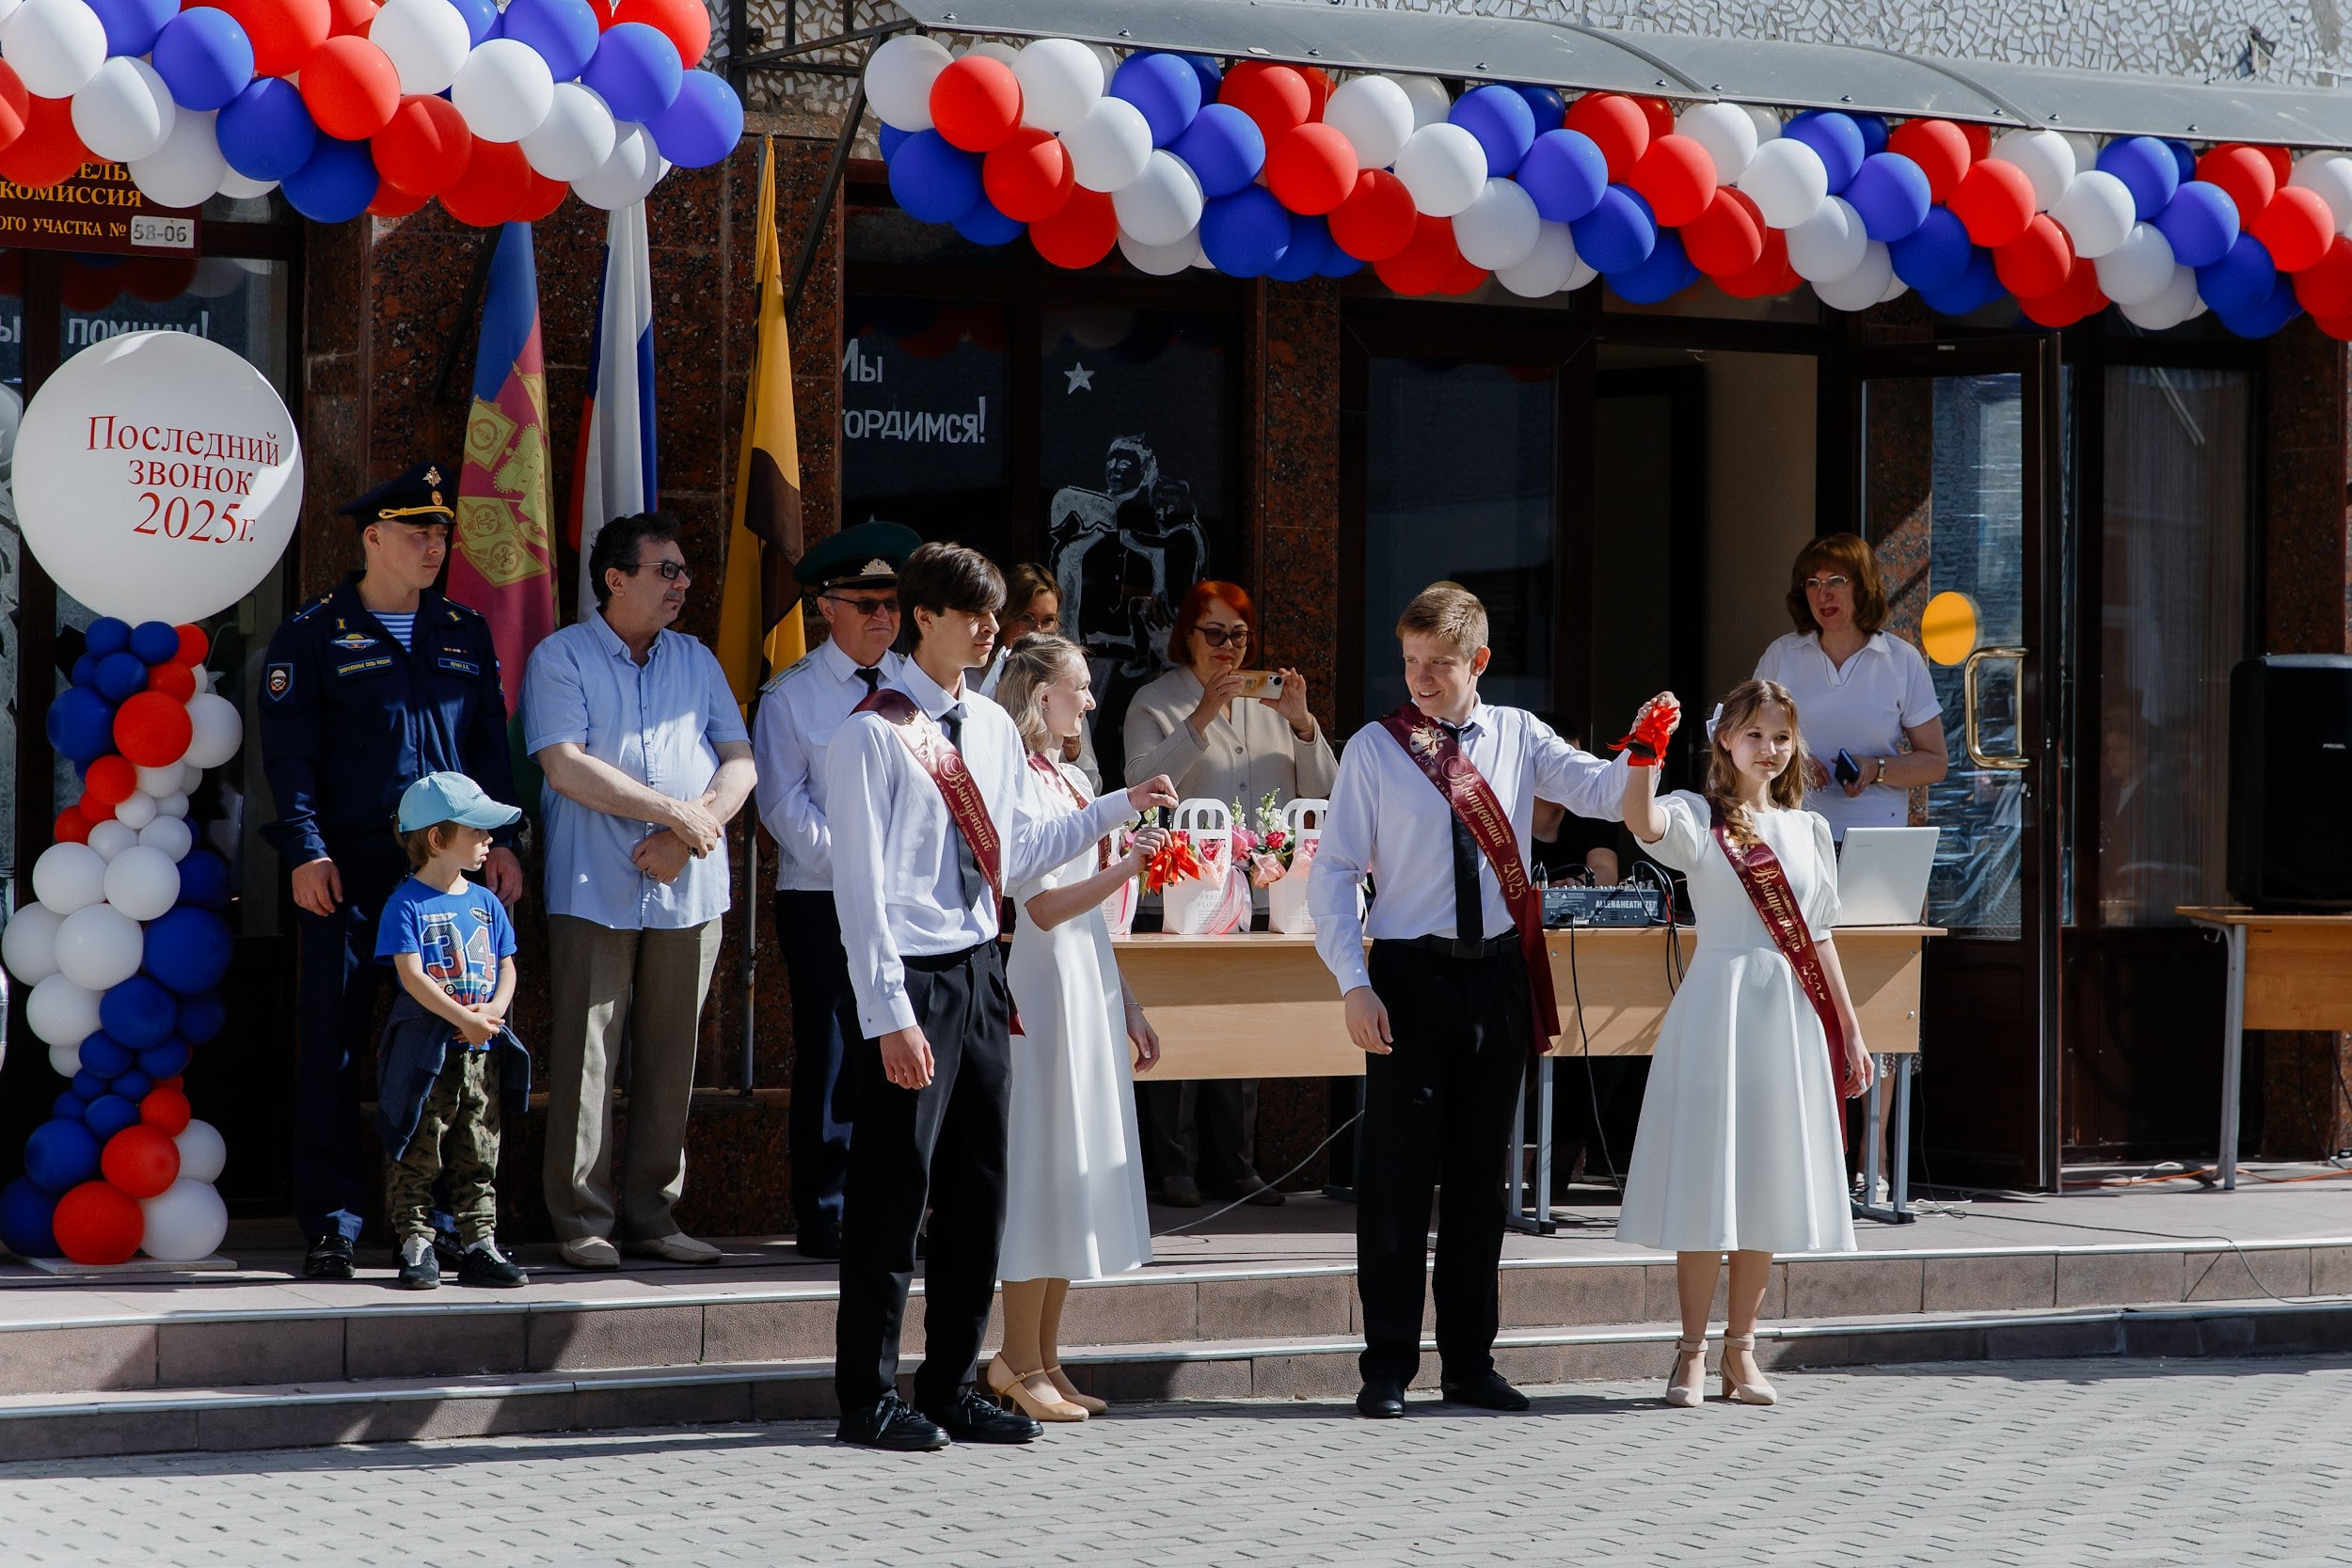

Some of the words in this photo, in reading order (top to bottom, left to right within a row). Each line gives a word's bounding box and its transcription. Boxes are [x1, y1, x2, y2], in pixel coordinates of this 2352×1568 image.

[0, 182, 142, 207] КОМИССИЯ
[72, 161, 134, 182] ЕЛЬ
[33, 217, 103, 236] УЧАСТКА
[109, 222, 127, 237] №
[134, 224, 187, 243] 58-06
[87, 415, 280, 467] Последний
[128, 459, 253, 496] звонок
[133, 492, 256, 544] 2025г.
[939, 753, 993, 852] Выпускник
[1441, 755, 1504, 847] Выпускник
[1502, 857, 1526, 900] 2025
[1748, 852, 1801, 953] Выпускница
[421, 923, 495, 984] 34
